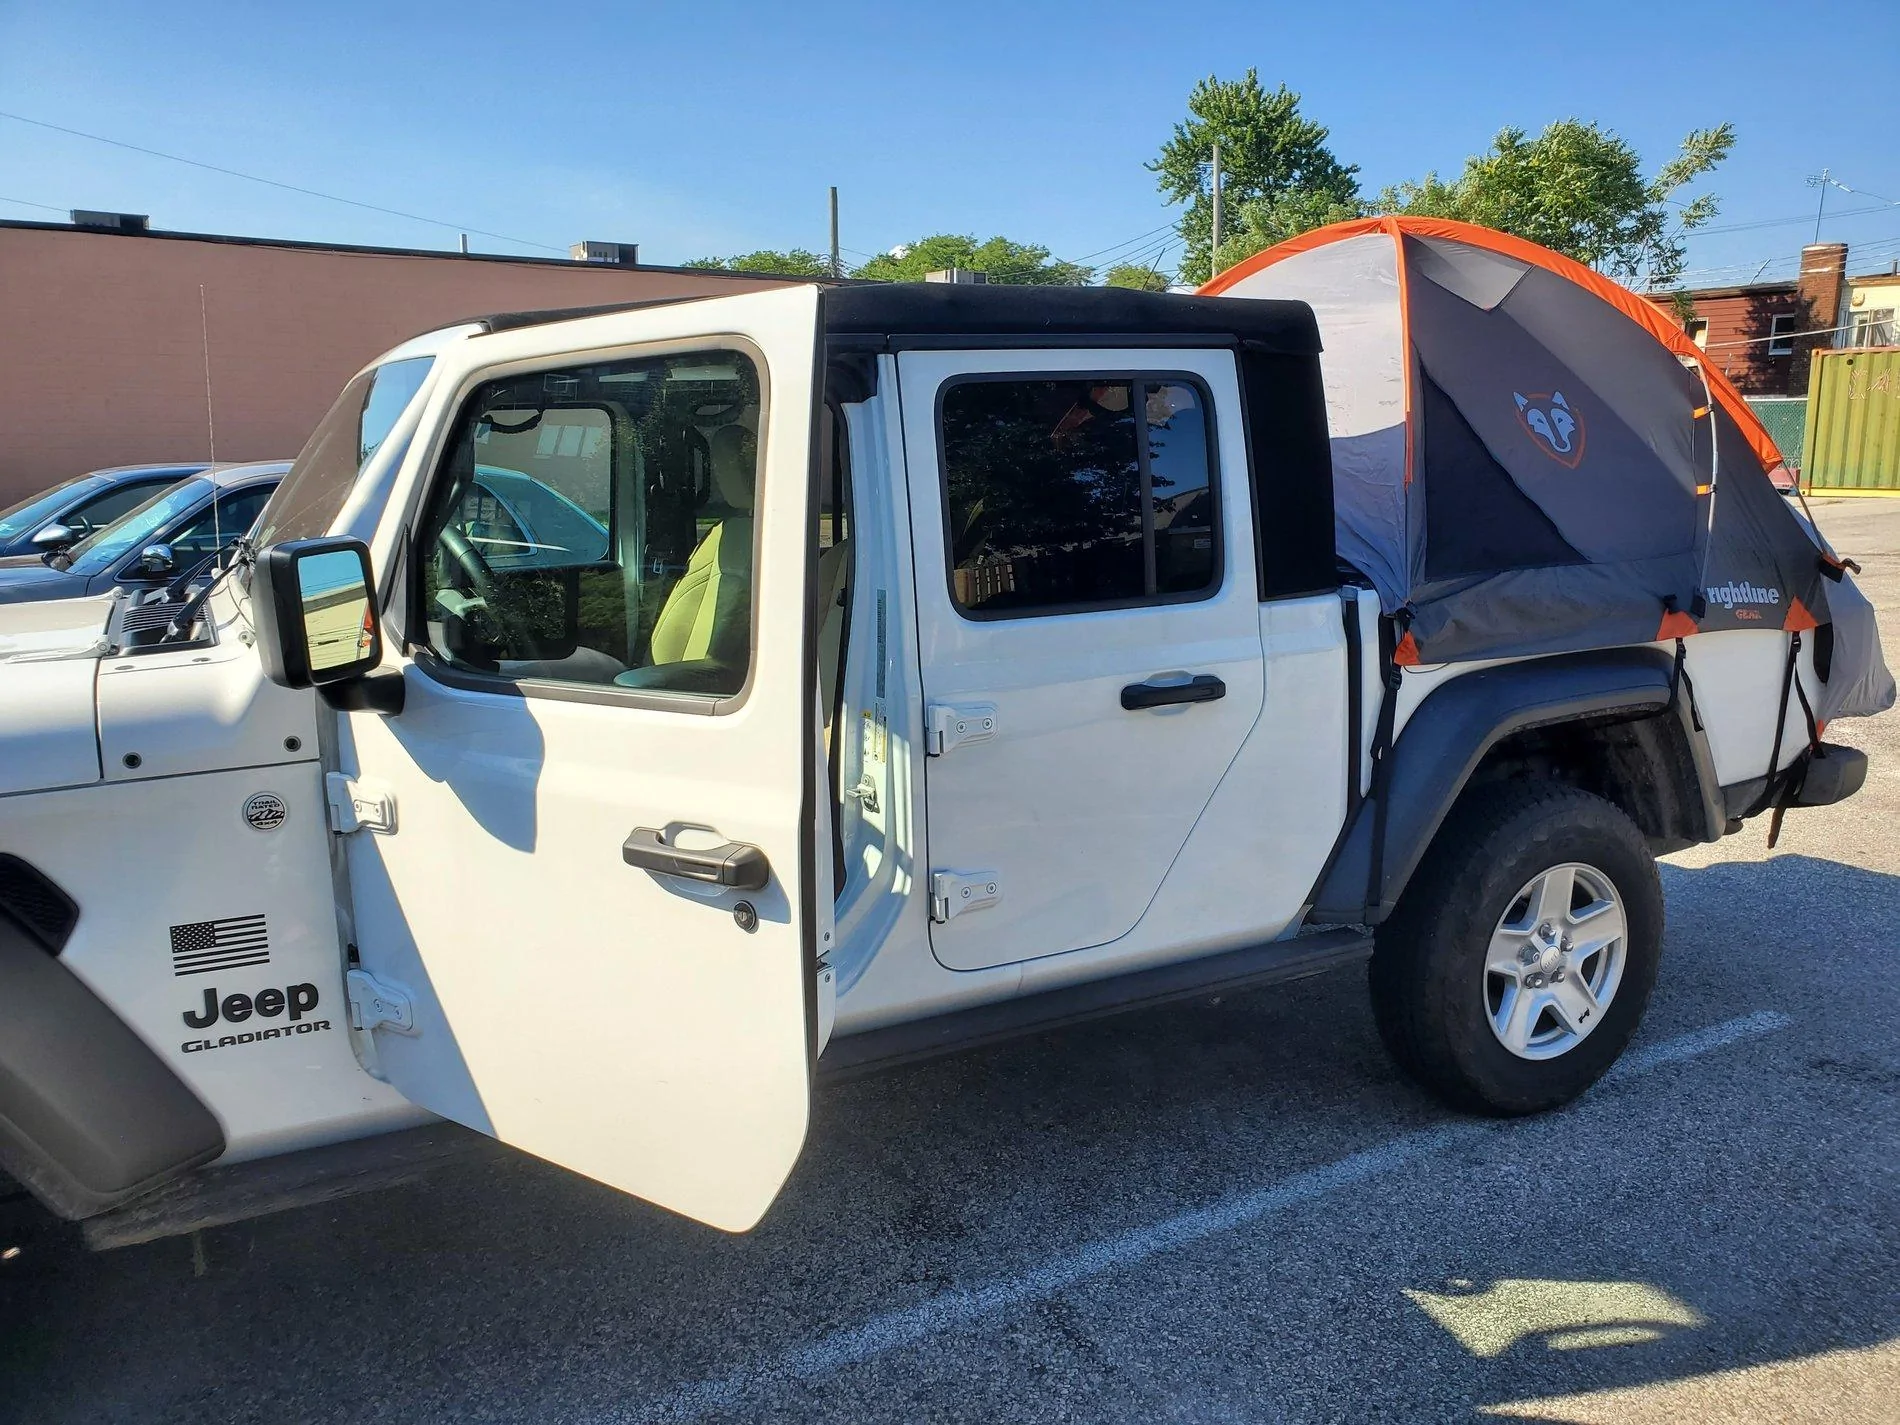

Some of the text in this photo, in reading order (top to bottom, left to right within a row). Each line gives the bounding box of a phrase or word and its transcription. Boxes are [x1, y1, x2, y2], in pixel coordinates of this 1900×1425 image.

[1706, 581, 1779, 608] rightline
[183, 982, 319, 1029] Jeep
[181, 1020, 332, 1053] GLADIATOR
